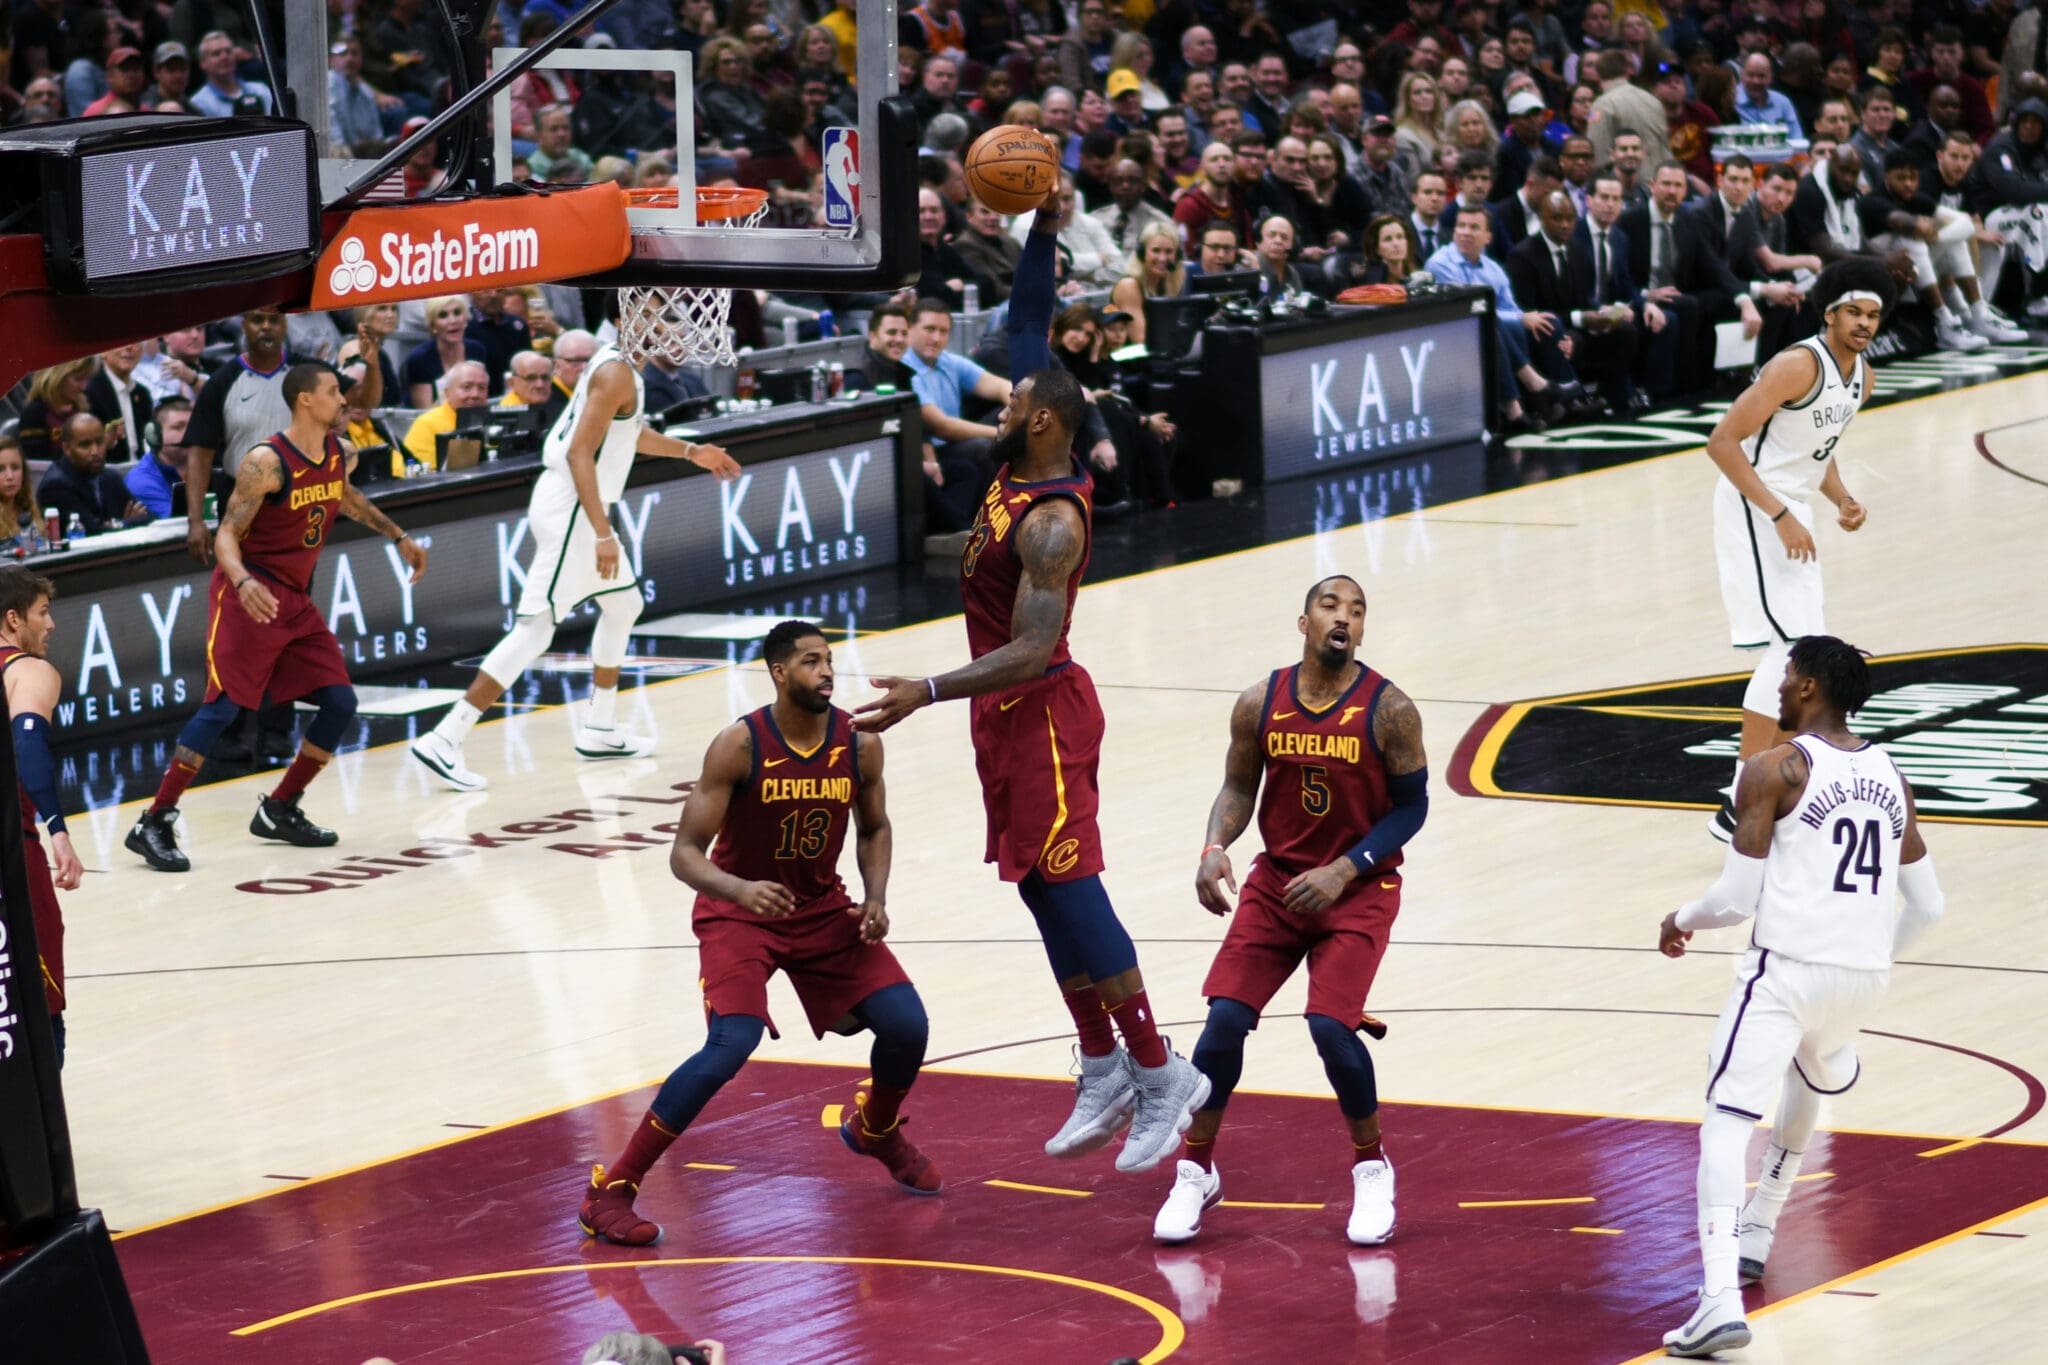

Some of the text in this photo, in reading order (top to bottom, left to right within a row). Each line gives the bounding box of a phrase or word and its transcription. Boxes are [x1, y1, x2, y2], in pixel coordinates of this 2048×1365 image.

[124, 147, 263, 235] KAY
[829, 203, 848, 220] NBA
[129, 222, 265, 260] JEWELERS
[1311, 341, 1430, 437] KAY
[1315, 417, 1431, 460] JEWELERS
[304, 505, 327, 548] 3
[721, 453, 865, 560] KAY
[498, 493, 654, 606] KY
[725, 534, 867, 586] JEWELERS
[328, 541, 420, 636] AY
[78, 586, 183, 695] AY
[340, 626, 428, 665] LERS
[58, 677, 187, 727] WELERS
[1268, 731, 1360, 765] CLEVELAND
[761, 777, 852, 804] CLEVELAND
[1301, 764, 1331, 817] 5
[1800, 777, 1904, 840] HOLLIS-JEFFERSON
[234, 808, 637, 895] Quicken
[774, 808, 832, 860] 13
[1832, 817, 1882, 895] 24
